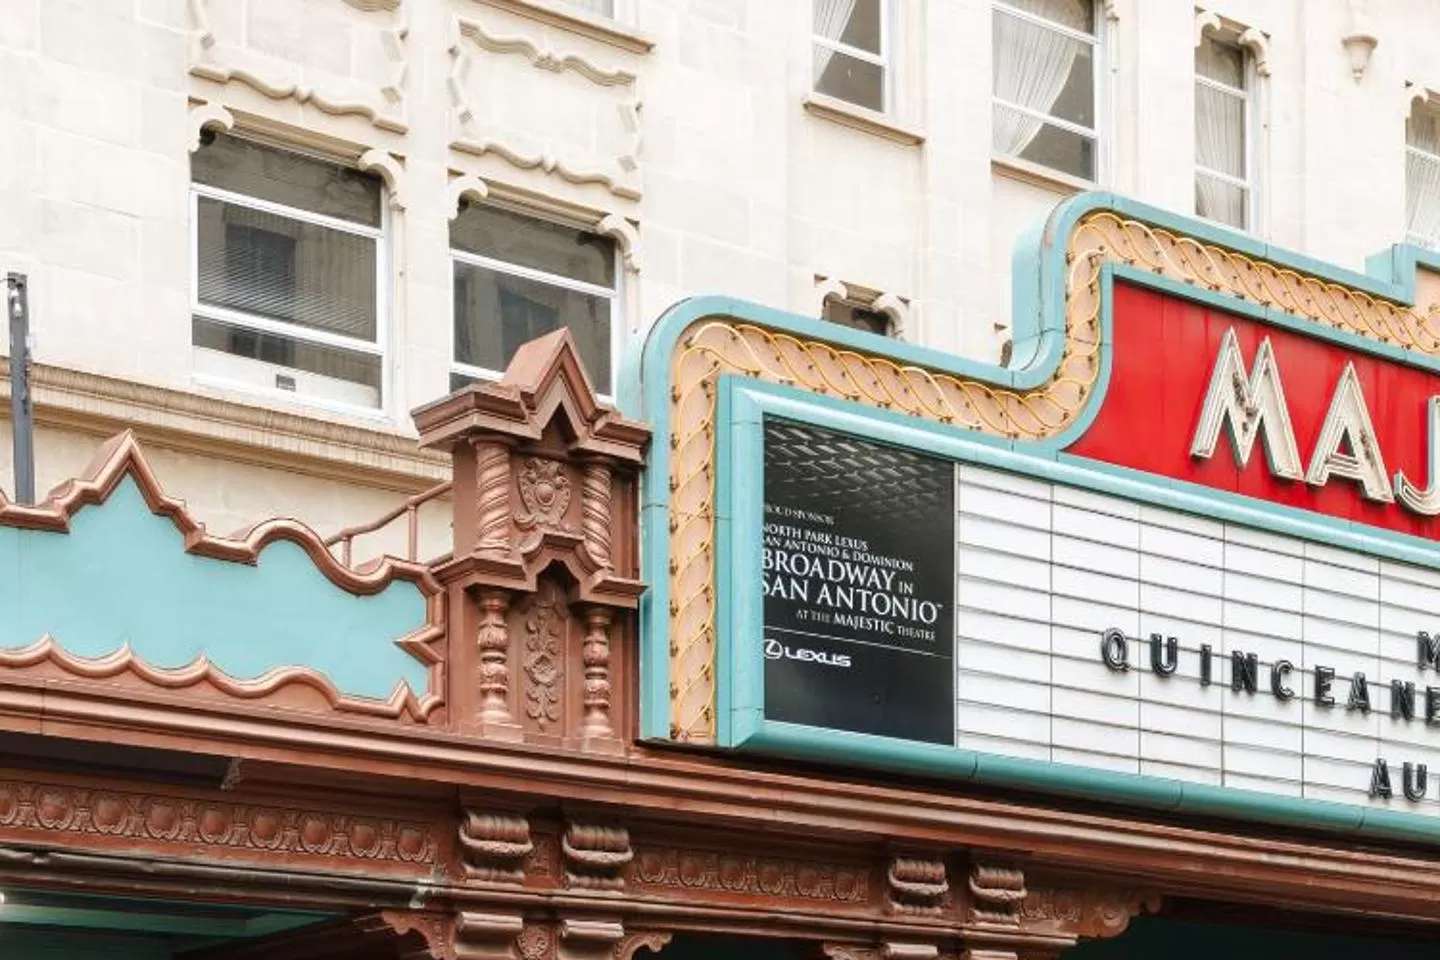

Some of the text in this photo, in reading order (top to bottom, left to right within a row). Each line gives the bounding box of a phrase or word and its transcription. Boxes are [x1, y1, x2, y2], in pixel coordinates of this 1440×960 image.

[763, 522, 868, 551] NORTH PARK LEXUS
[763, 536, 781, 547] AN
[784, 537, 839, 557] ANTONIO
[853, 550, 913, 572] DOMINION
[762, 548, 913, 596] BROADWAY IN
[762, 573, 938, 625] SAN ANTONIO
[796, 609, 808, 620] AT
[833, 612, 894, 635] MAJESTIC
[785, 646, 851, 668] LEXUS
